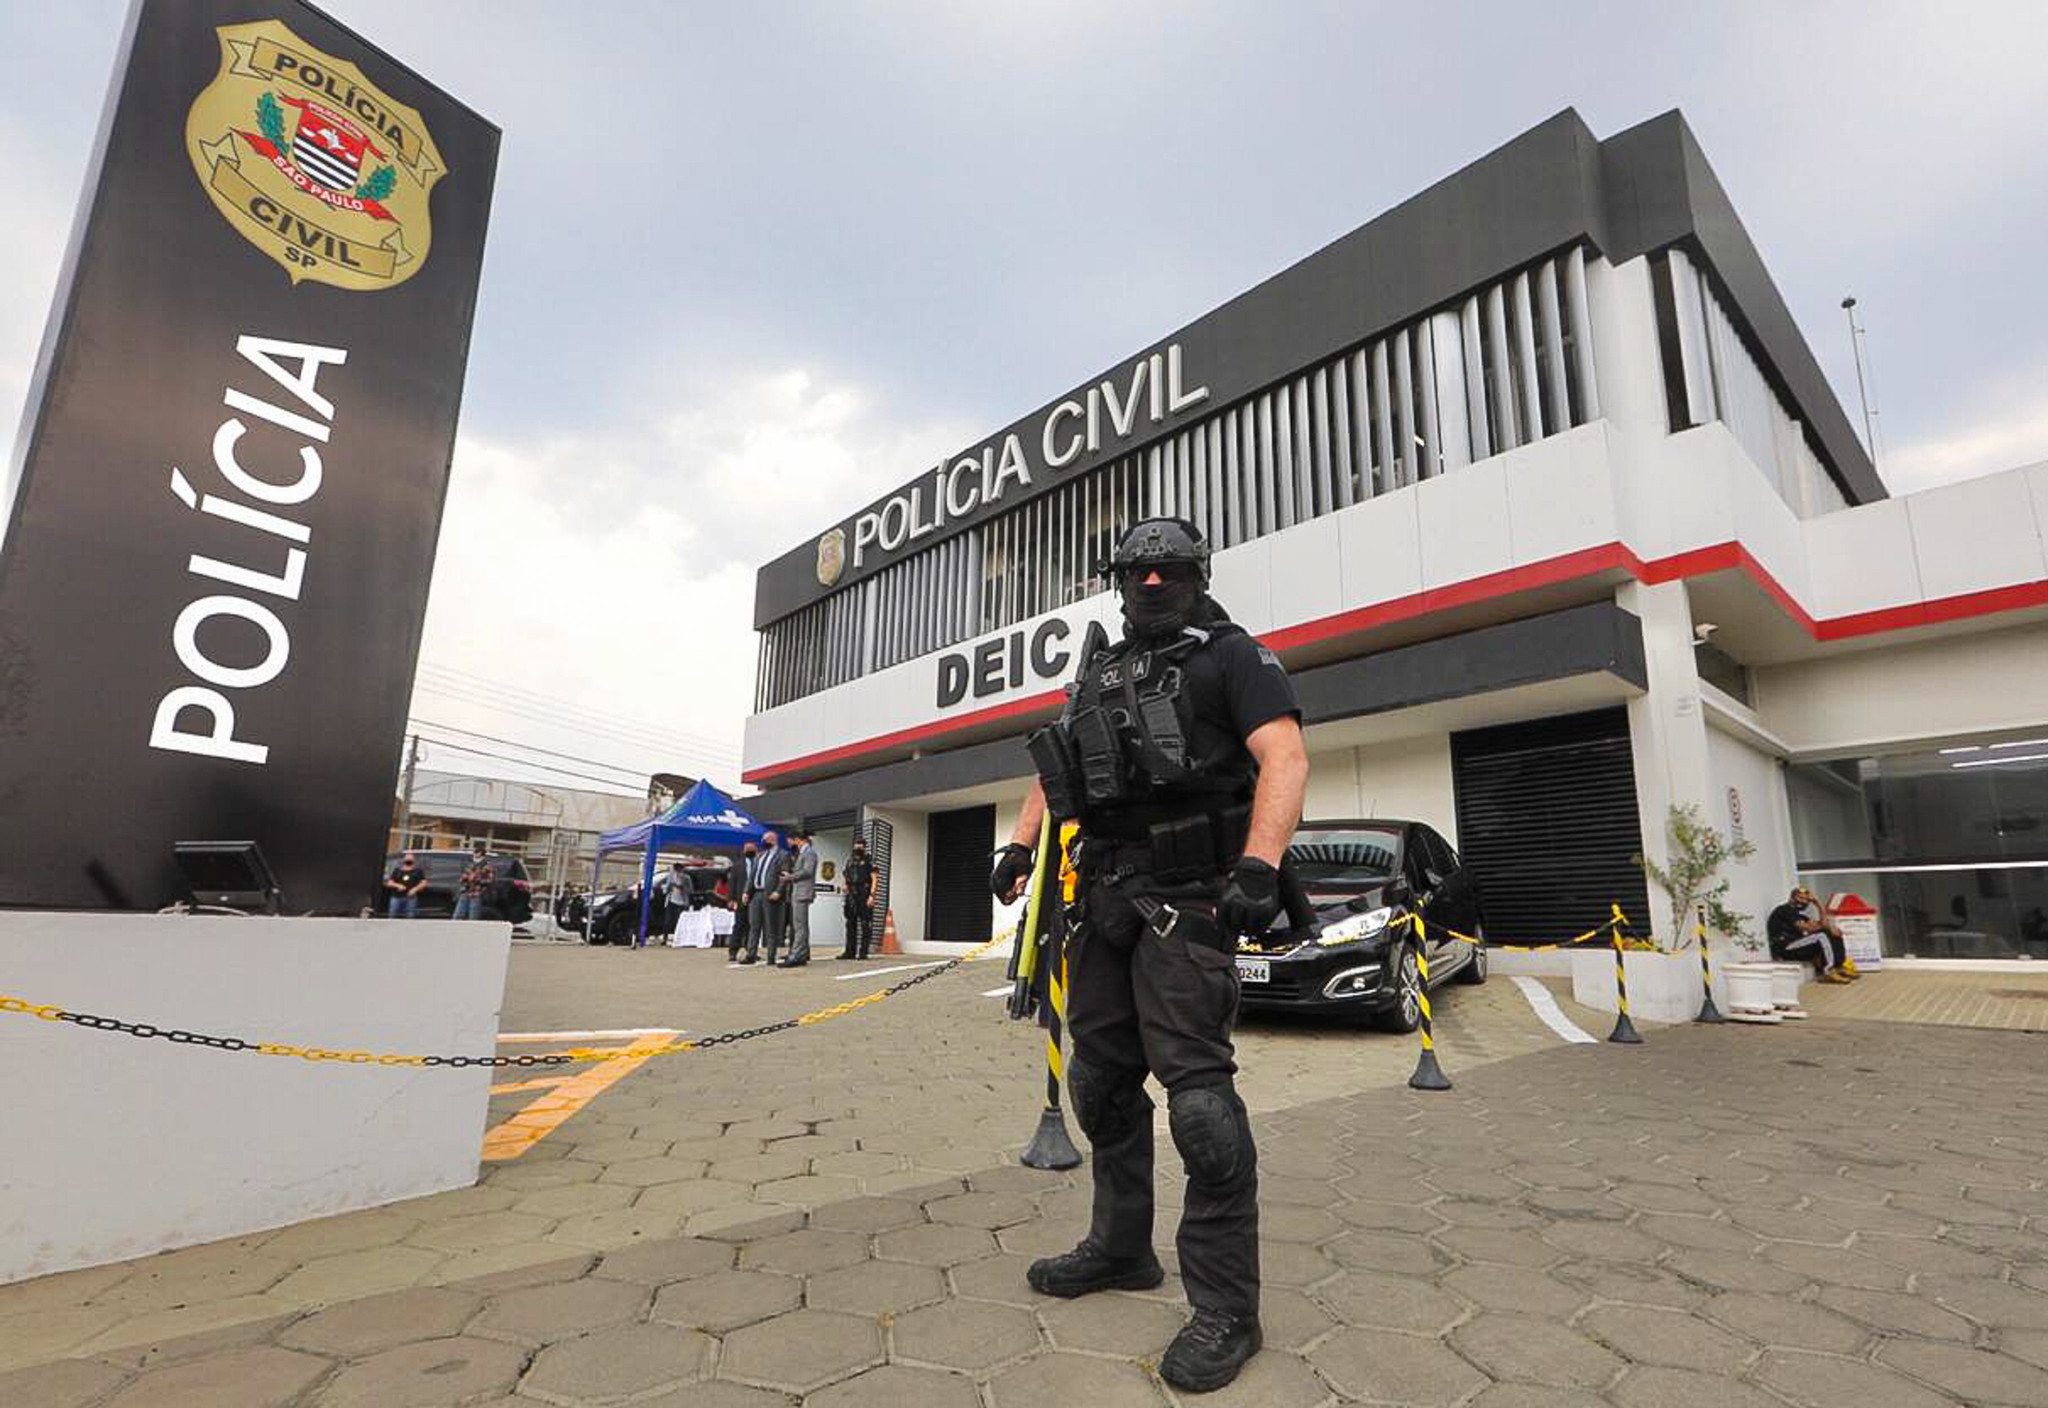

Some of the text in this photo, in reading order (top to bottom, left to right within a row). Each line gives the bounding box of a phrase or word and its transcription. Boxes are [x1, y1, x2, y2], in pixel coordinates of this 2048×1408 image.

[273, 52, 404, 151] POLÍCIA
[250, 196, 361, 268] CIVIL
[310, 184, 364, 211] PAULO
[284, 246, 317, 269] SP
[853, 343, 1210, 569] POLÍCIA CIVIL
[149, 334, 348, 764] POLÍCIA
[937, 617, 1070, 709] DEIC
